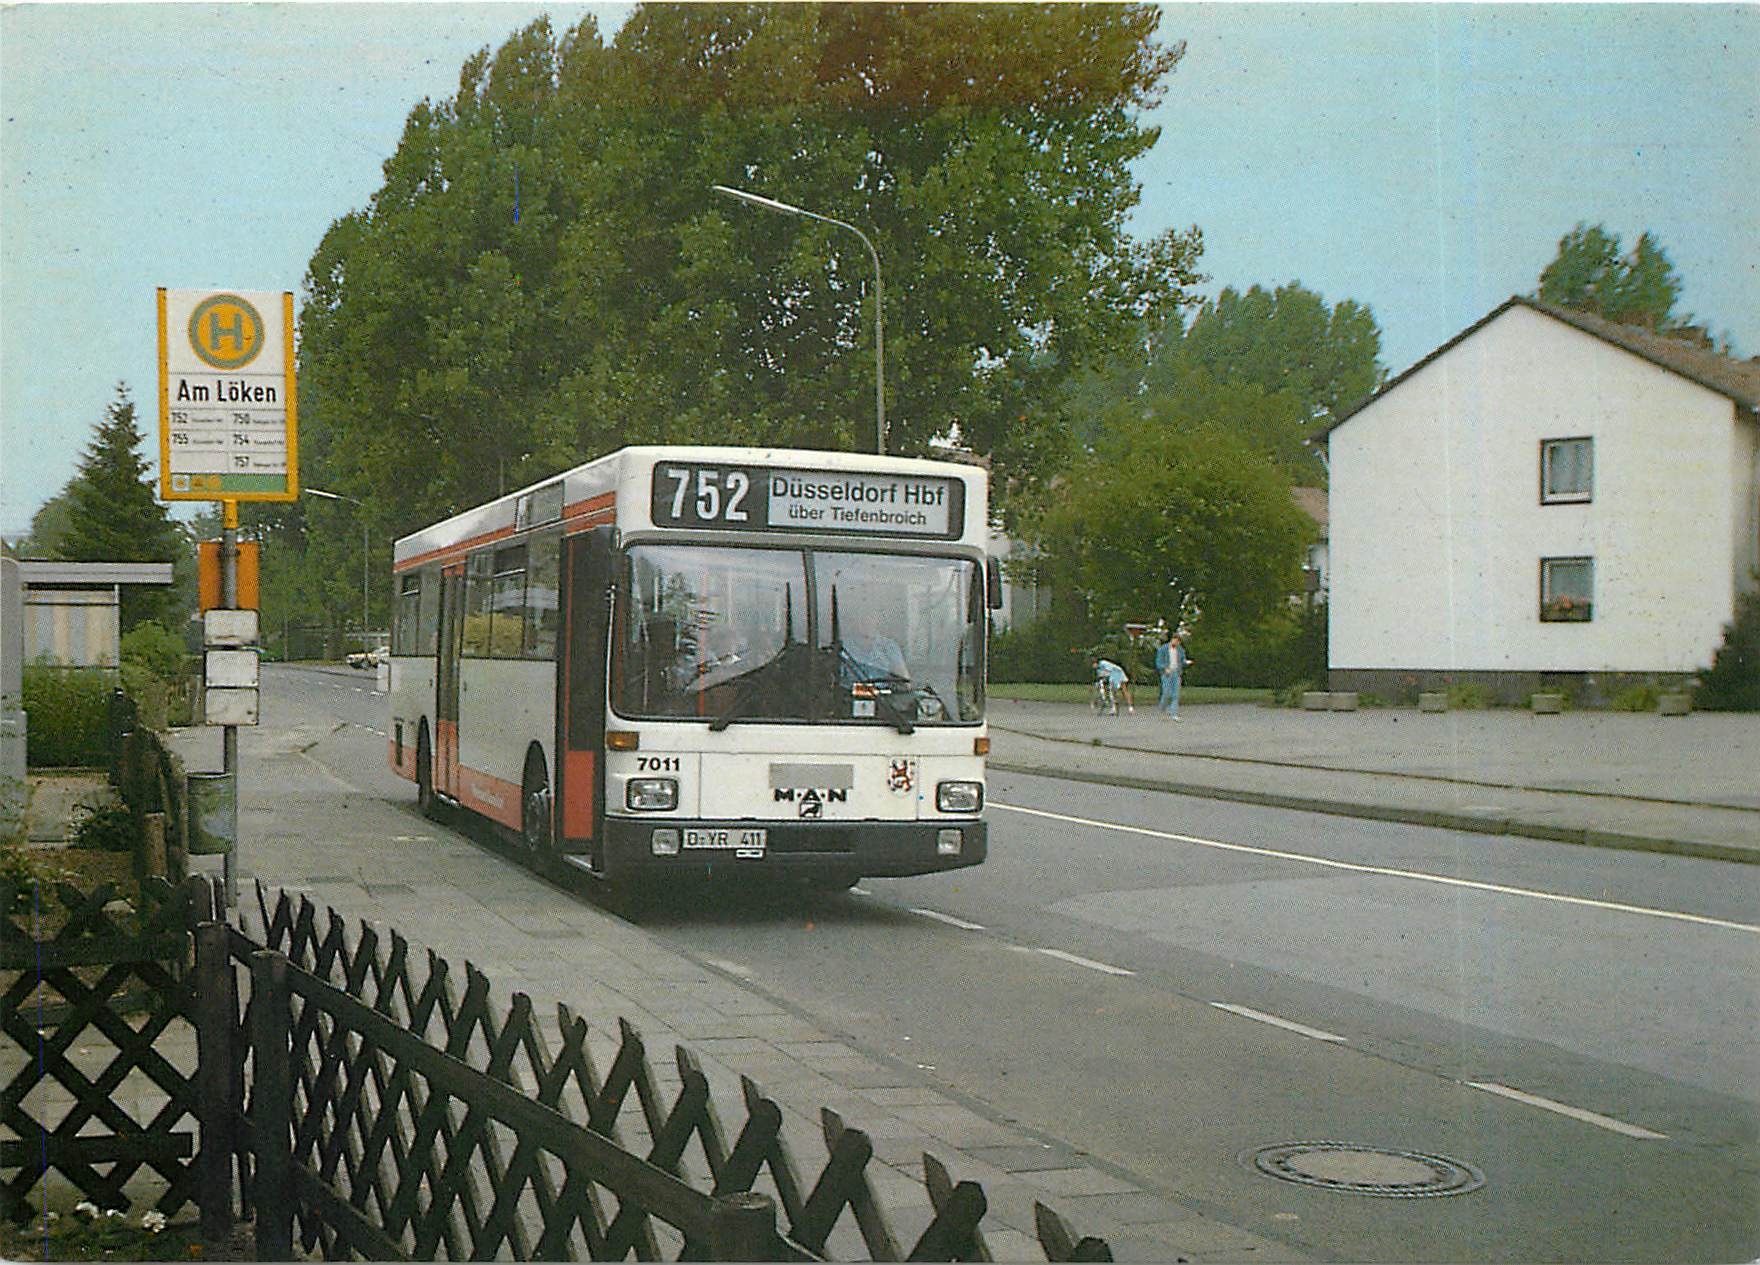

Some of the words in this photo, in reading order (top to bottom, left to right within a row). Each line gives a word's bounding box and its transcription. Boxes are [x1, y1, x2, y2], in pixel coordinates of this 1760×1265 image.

[178, 379, 209, 402] Am
[218, 380, 276, 402] Löken
[668, 468, 749, 521] 752
[772, 477, 897, 504] Düsseldorf
[905, 484, 945, 506] Hbf
[789, 504, 824, 521] über
[830, 507, 927, 525] Tiefenbroich
[637, 757, 680, 771] 7011
